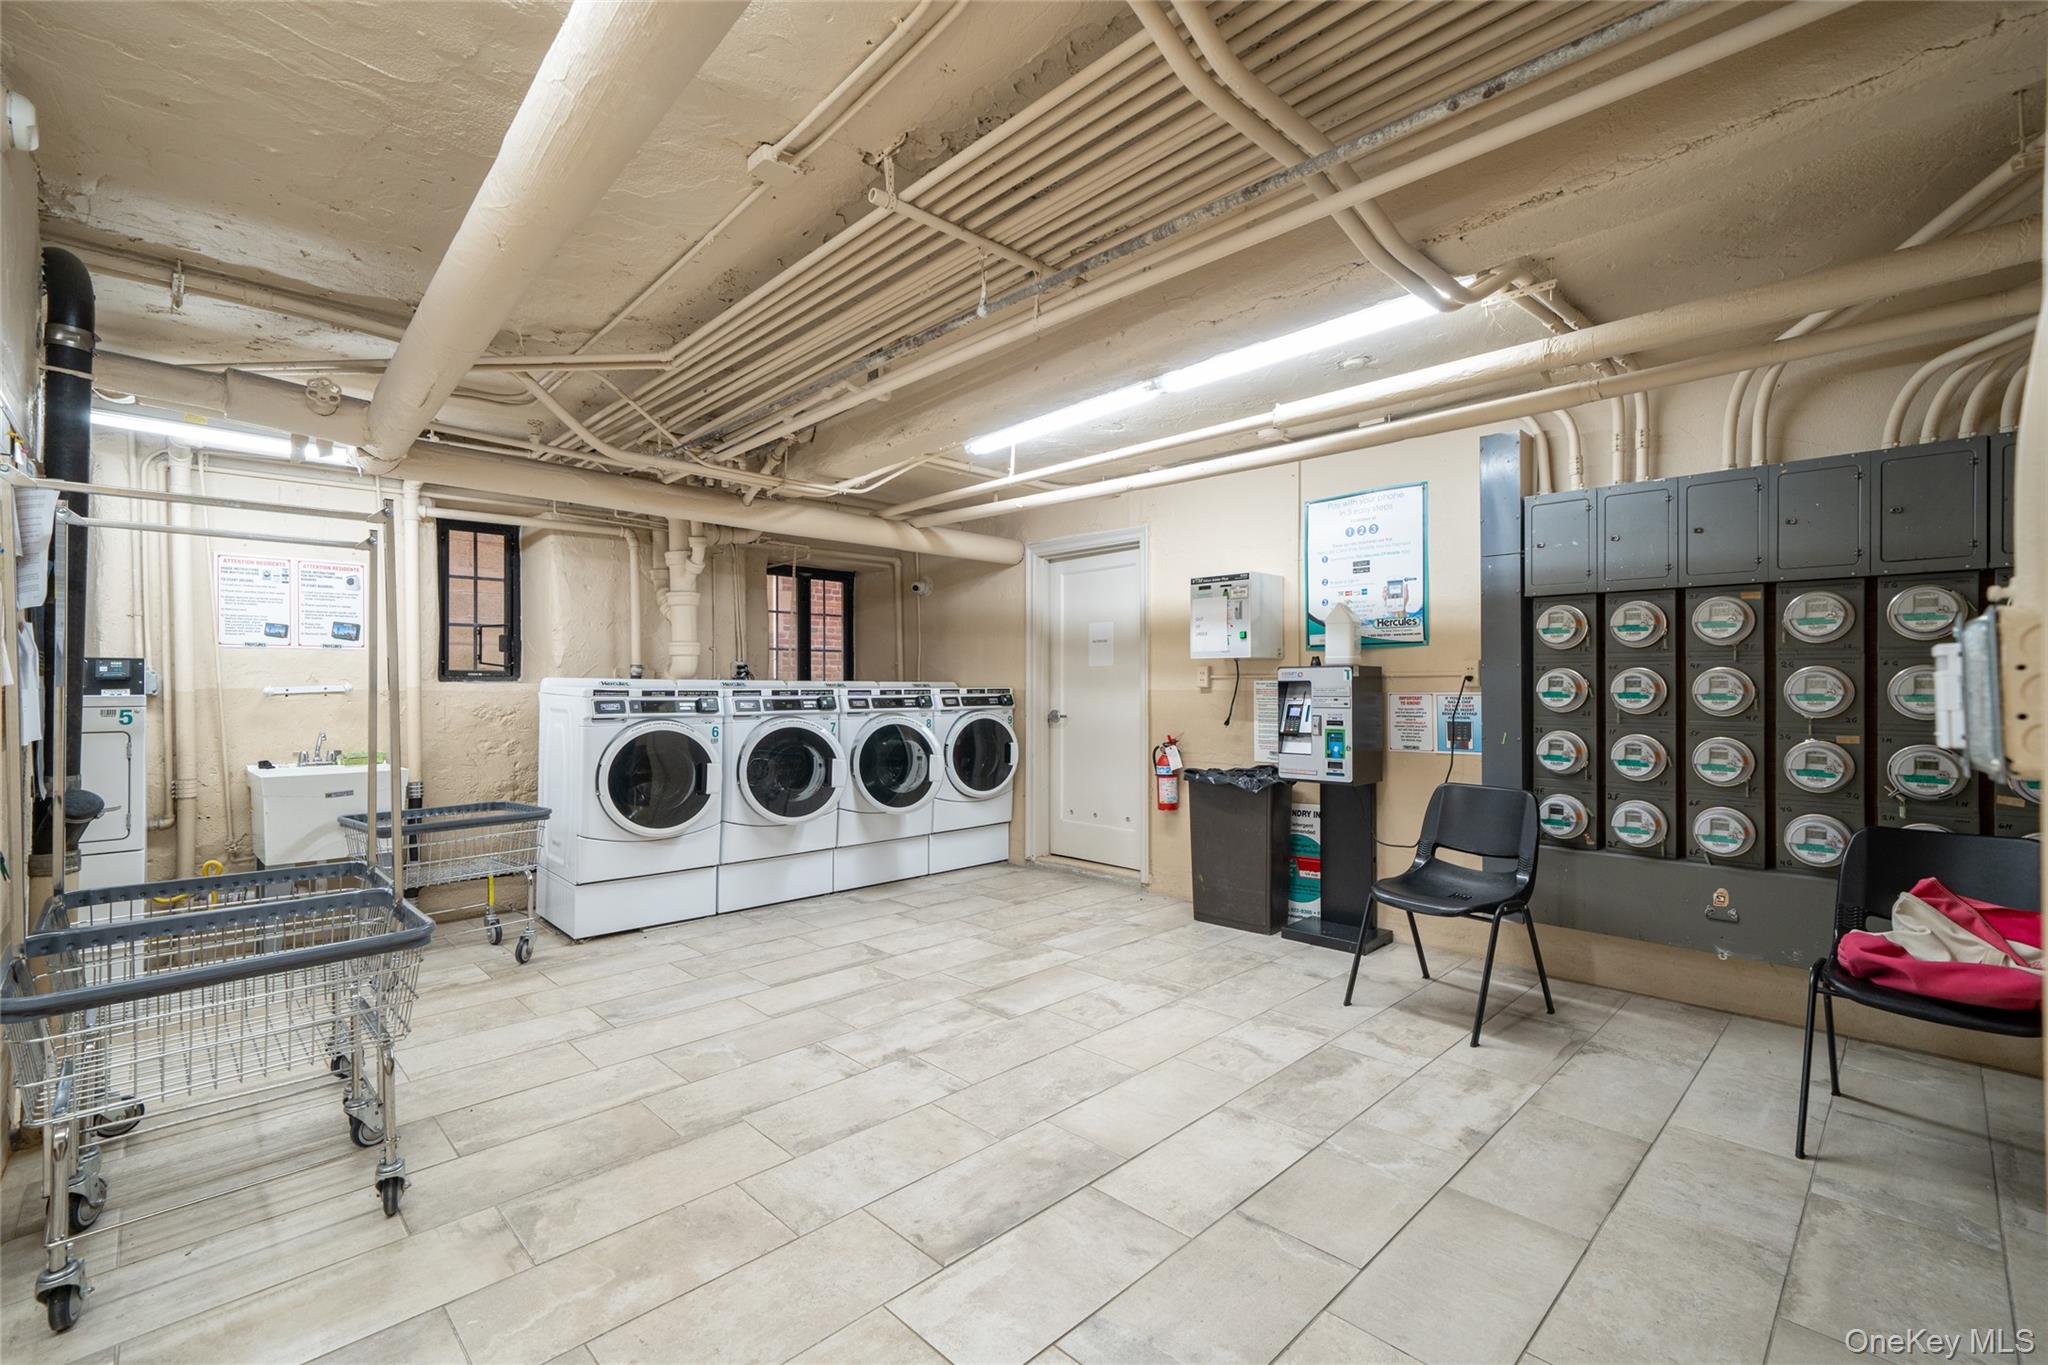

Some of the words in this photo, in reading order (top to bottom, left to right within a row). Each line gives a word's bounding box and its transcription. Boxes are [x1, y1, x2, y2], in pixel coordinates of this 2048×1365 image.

[1376, 617, 1417, 627] Hercules
[118, 709, 133, 725] 5
[1008, 715, 1013, 725] 9
[830, 722, 836, 734] 7
[926, 719, 932, 729] 8
[711, 726, 719, 738] 6
